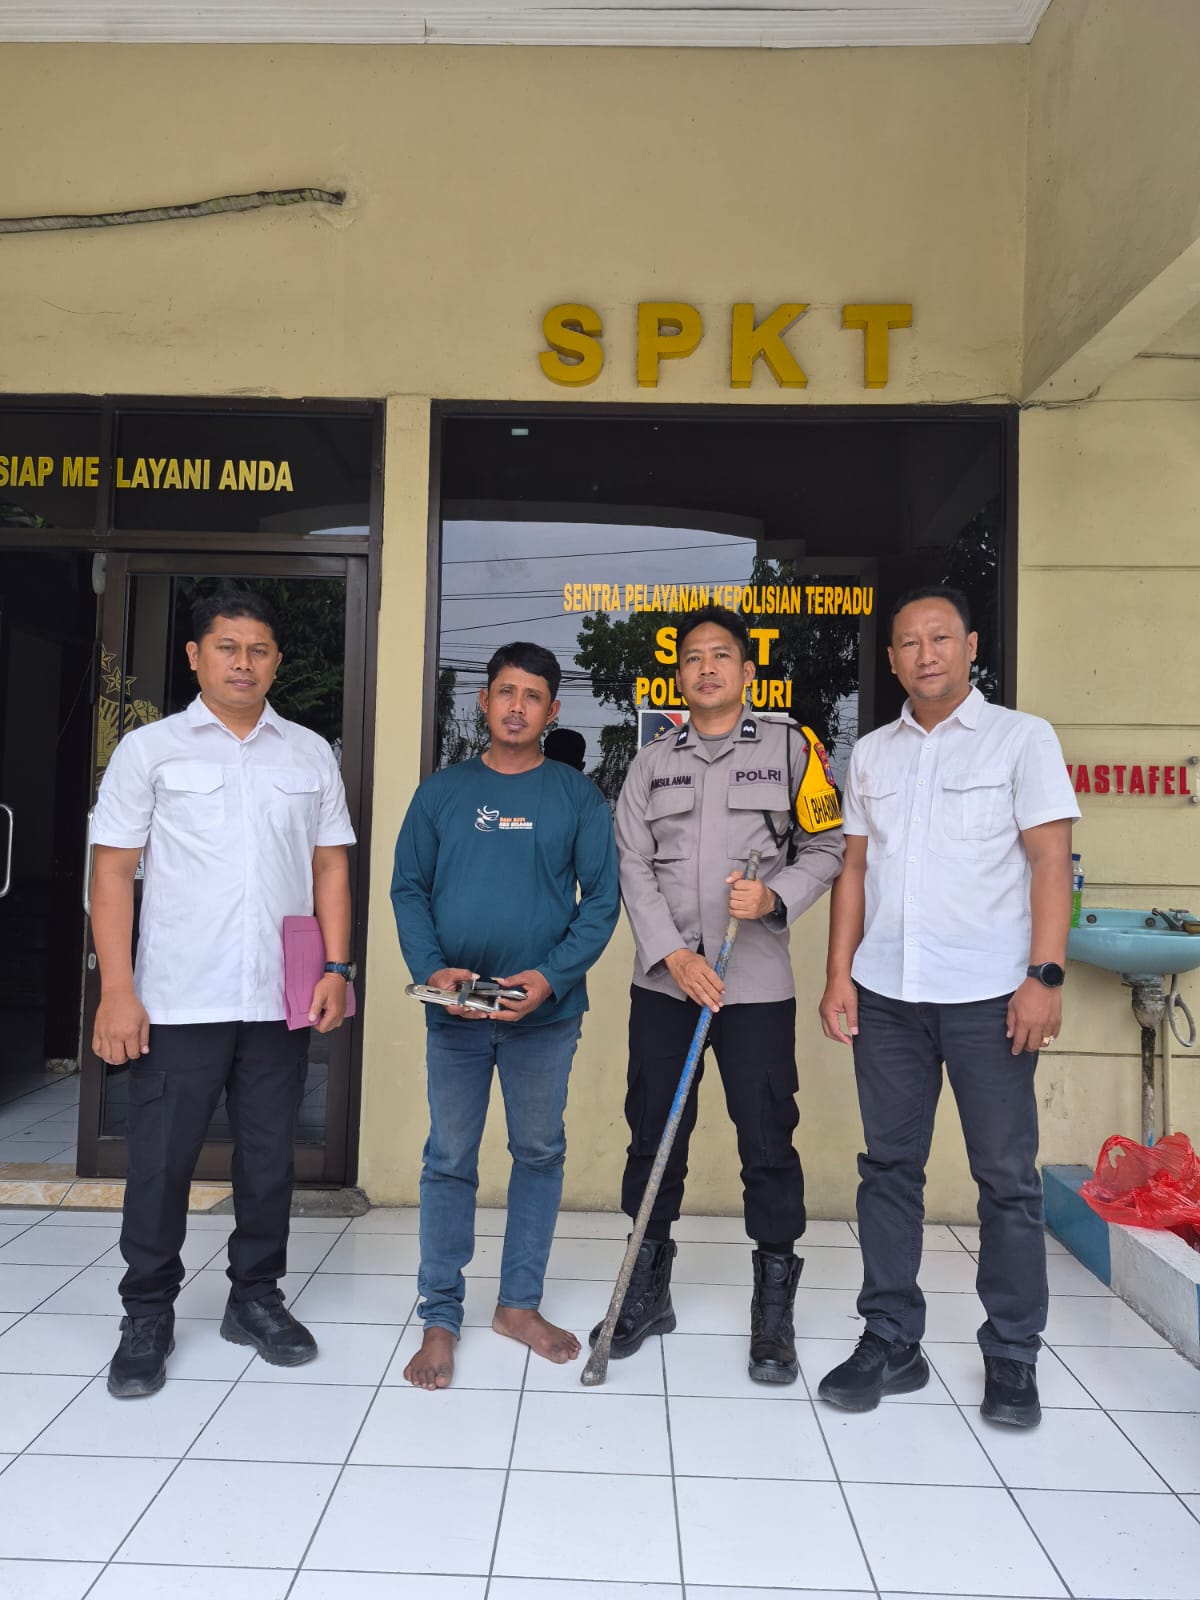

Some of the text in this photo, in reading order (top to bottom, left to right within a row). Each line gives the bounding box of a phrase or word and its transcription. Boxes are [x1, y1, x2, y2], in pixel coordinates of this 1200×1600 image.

[539, 303, 912, 389] SPKT
[0, 456, 53, 487] SIAP
[218, 460, 293, 492] ANDA
[563, 582, 873, 616] SENTRA PELAYANAN KEPOLISIAN TERPADU
[655, 626, 779, 666] ST
[635, 677, 688, 706] POL
[736, 769, 782, 783] POLRI
[1066, 764, 1191, 795] ASTAFEL
